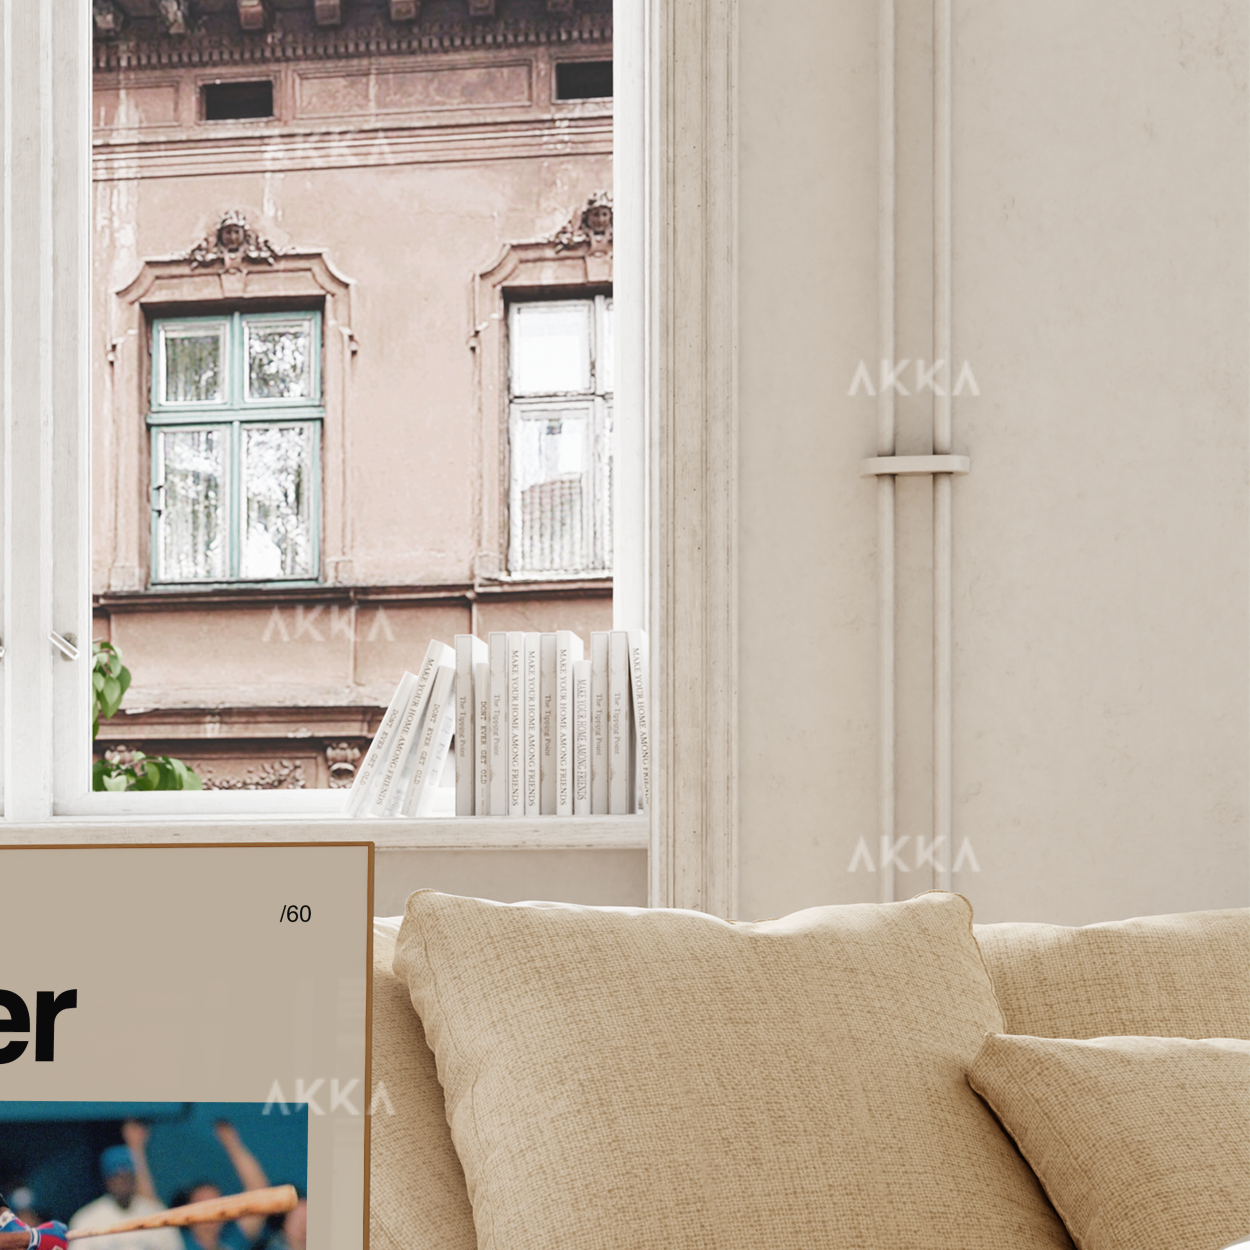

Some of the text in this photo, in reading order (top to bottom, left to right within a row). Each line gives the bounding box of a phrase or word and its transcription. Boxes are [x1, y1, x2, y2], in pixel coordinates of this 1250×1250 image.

[632, 647, 640, 674] MAKE
[634, 674, 644, 701] YOUR
[376, 658, 435, 805] MAKE YOUR HOME AMONG FRIENDS
[413, 703, 440, 785] DONT EVER GET OLD
[511, 650, 519, 807] MAKE YOUR HOME AMONG FRIENDS
[528, 651, 536, 807] MAKE YOUR HOME AMONG FRIENDS
[543, 710, 551, 738] Tipping
[559, 648, 567, 806] MAKE YOUR HOME AMONG FRIENDS
[637, 702, 647, 730] HOME
[360, 709, 399, 786] DONT EVER GET OLD
[640, 730, 649, 766] AMONG
[279, 904, 311, 922] /60
